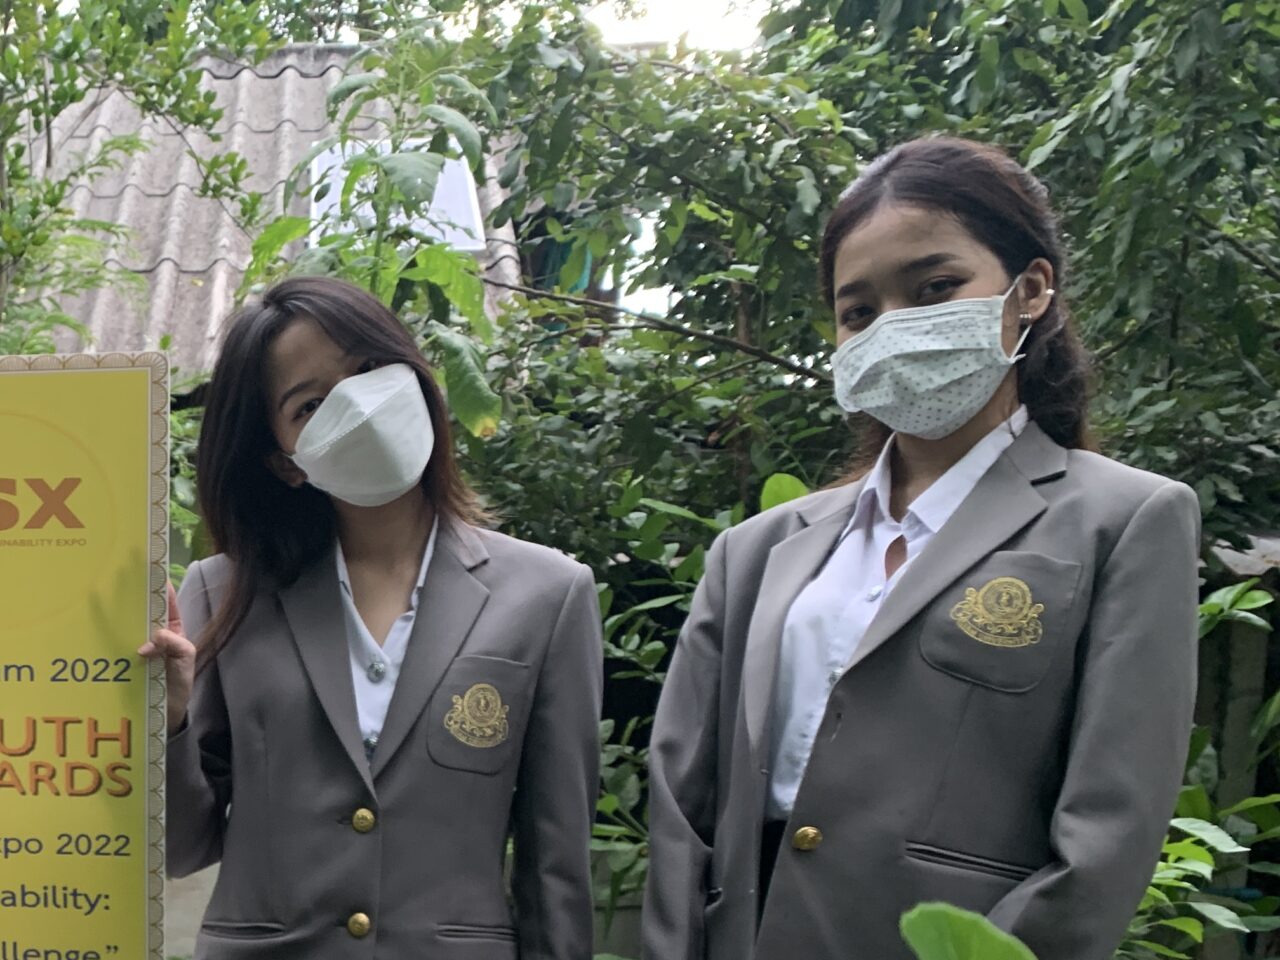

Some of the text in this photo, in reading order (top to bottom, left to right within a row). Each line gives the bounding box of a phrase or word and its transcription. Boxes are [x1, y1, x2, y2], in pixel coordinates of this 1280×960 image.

[56, 537, 88, 547] EXPO
[50, 659, 132, 683] 2022
[56, 834, 132, 857] 2022
